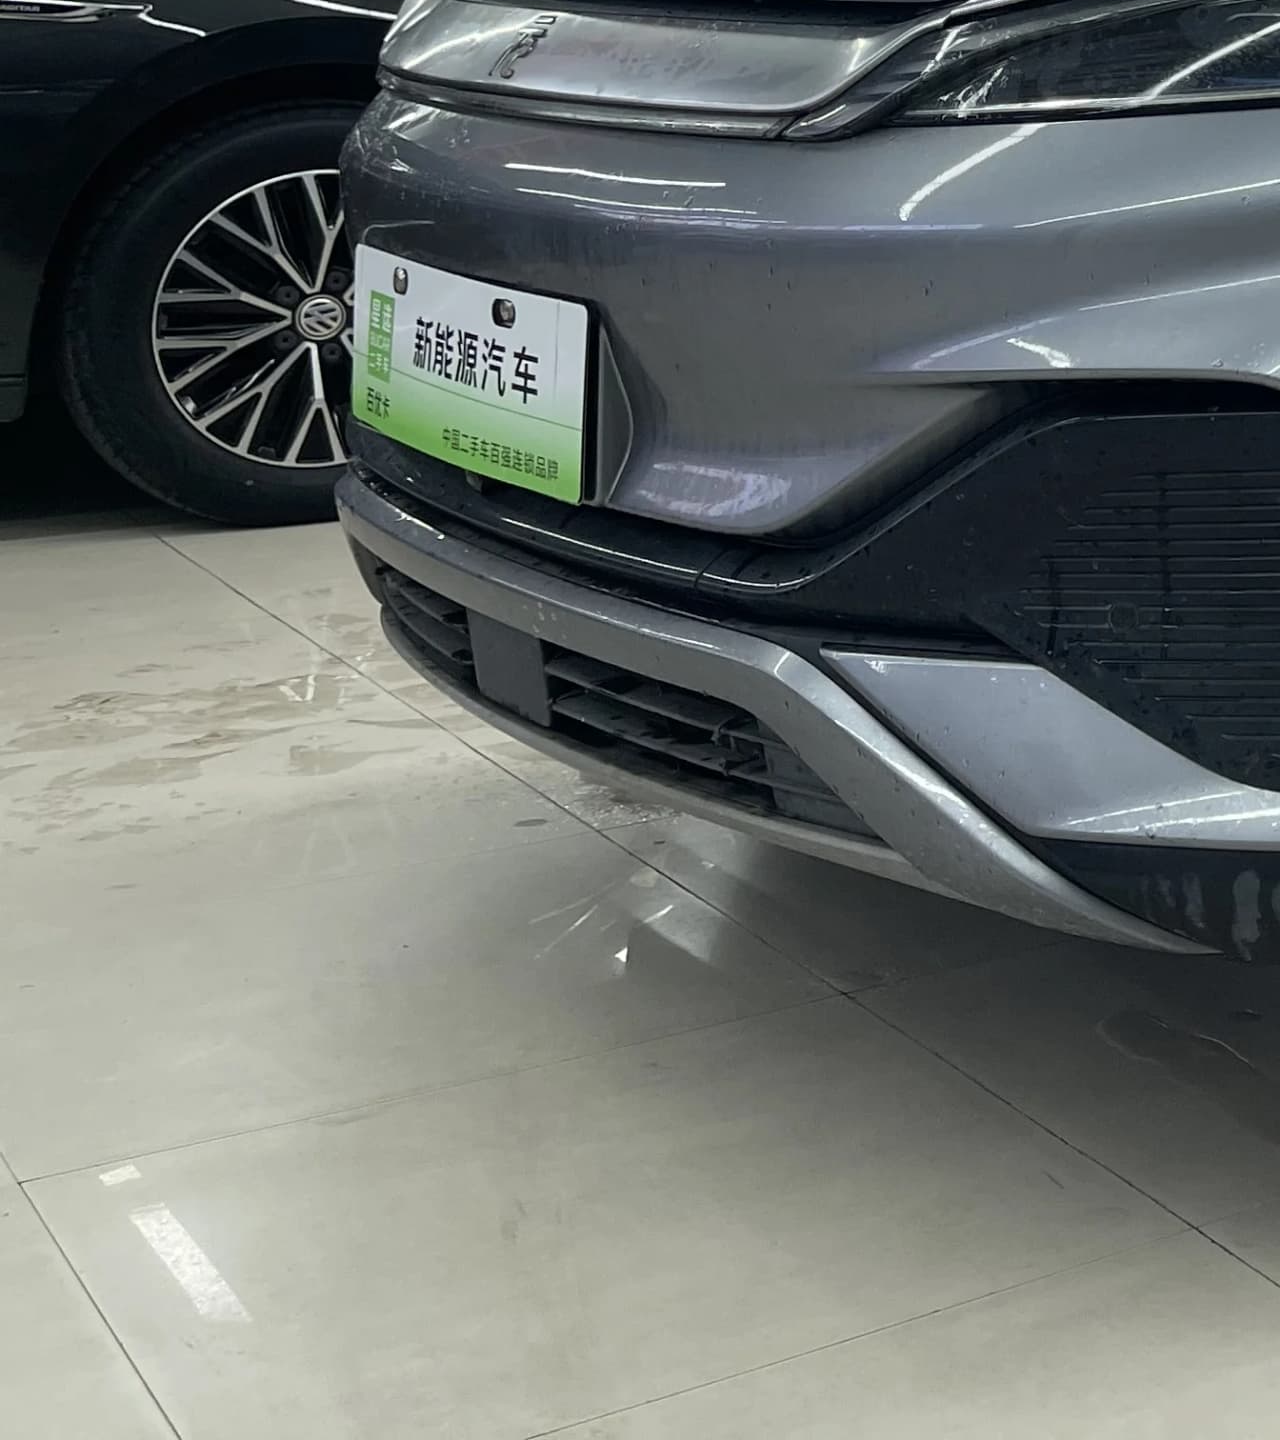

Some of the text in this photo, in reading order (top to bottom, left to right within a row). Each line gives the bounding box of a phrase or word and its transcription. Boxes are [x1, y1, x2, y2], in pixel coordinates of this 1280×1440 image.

[412, 317, 539, 405] 新能源汽车
[441, 427, 559, 481] 中国二手车百强连锁品牌
